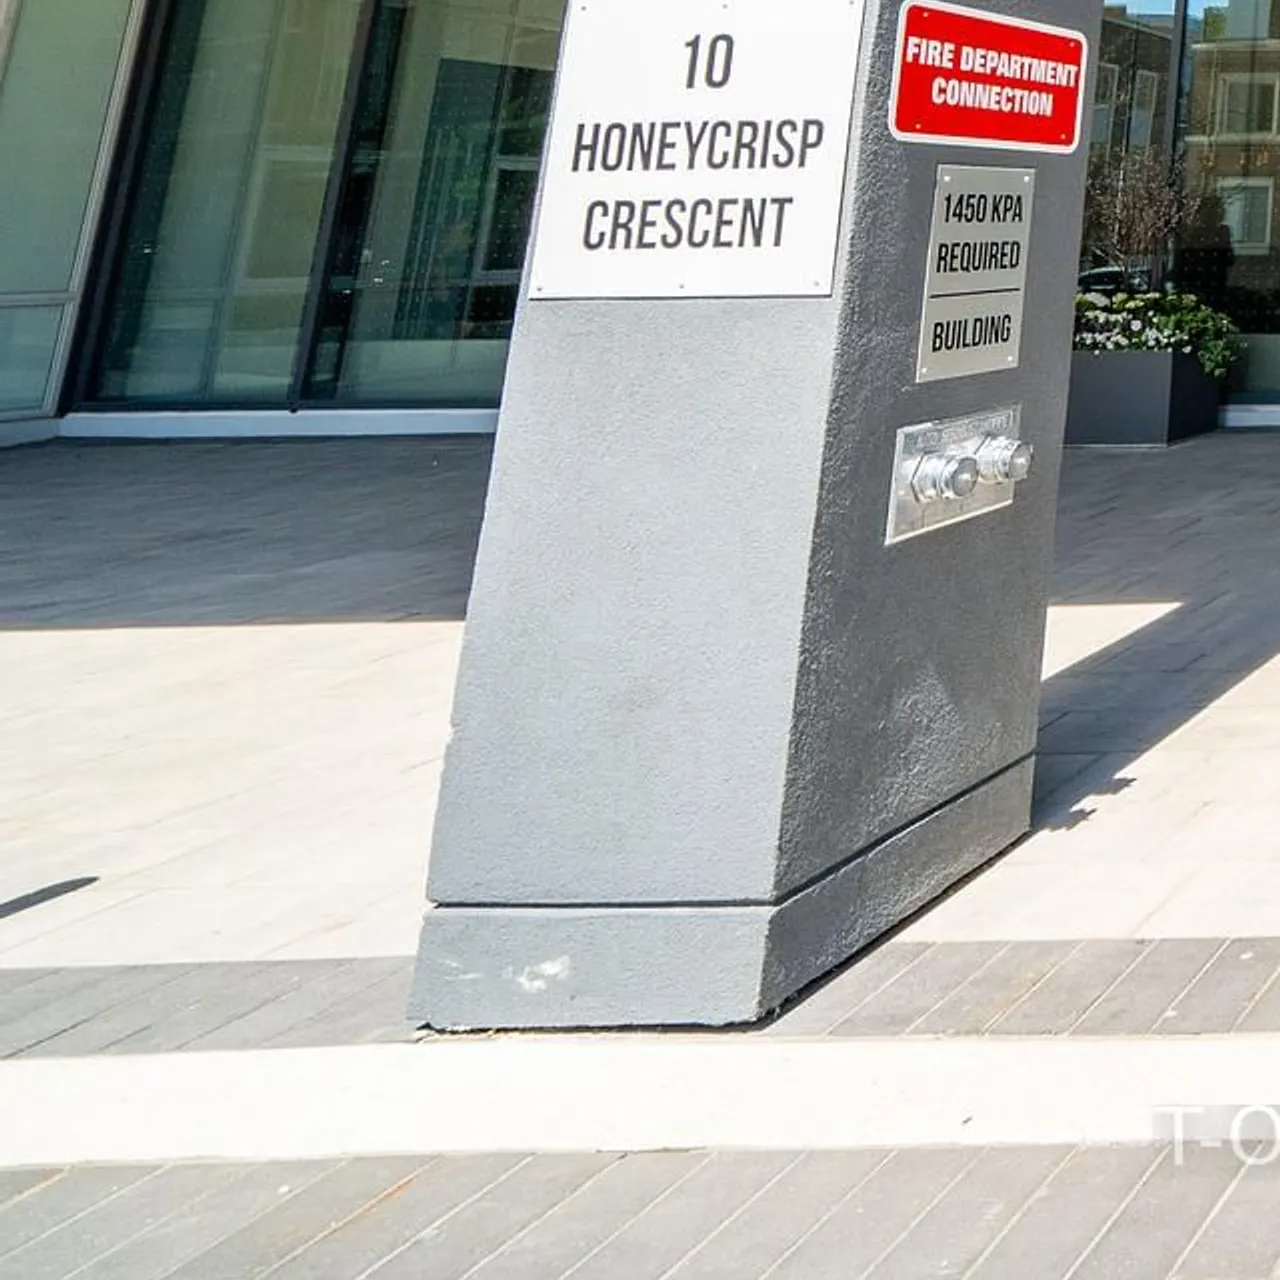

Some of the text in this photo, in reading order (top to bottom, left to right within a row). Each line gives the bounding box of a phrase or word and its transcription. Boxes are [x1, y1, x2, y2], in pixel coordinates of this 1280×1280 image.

[684, 33, 734, 90] 10
[906, 36, 1079, 87] FIRE DEPARTMENT
[931, 77, 1053, 117] CONNECTION
[571, 119, 824, 172] HONEYCRISP
[582, 196, 794, 251] CRESCENT
[943, 193, 1023, 224] 1450 KPA
[937, 241, 1020, 274] REQUIRED
[932, 314, 1012, 353] BUILDING
